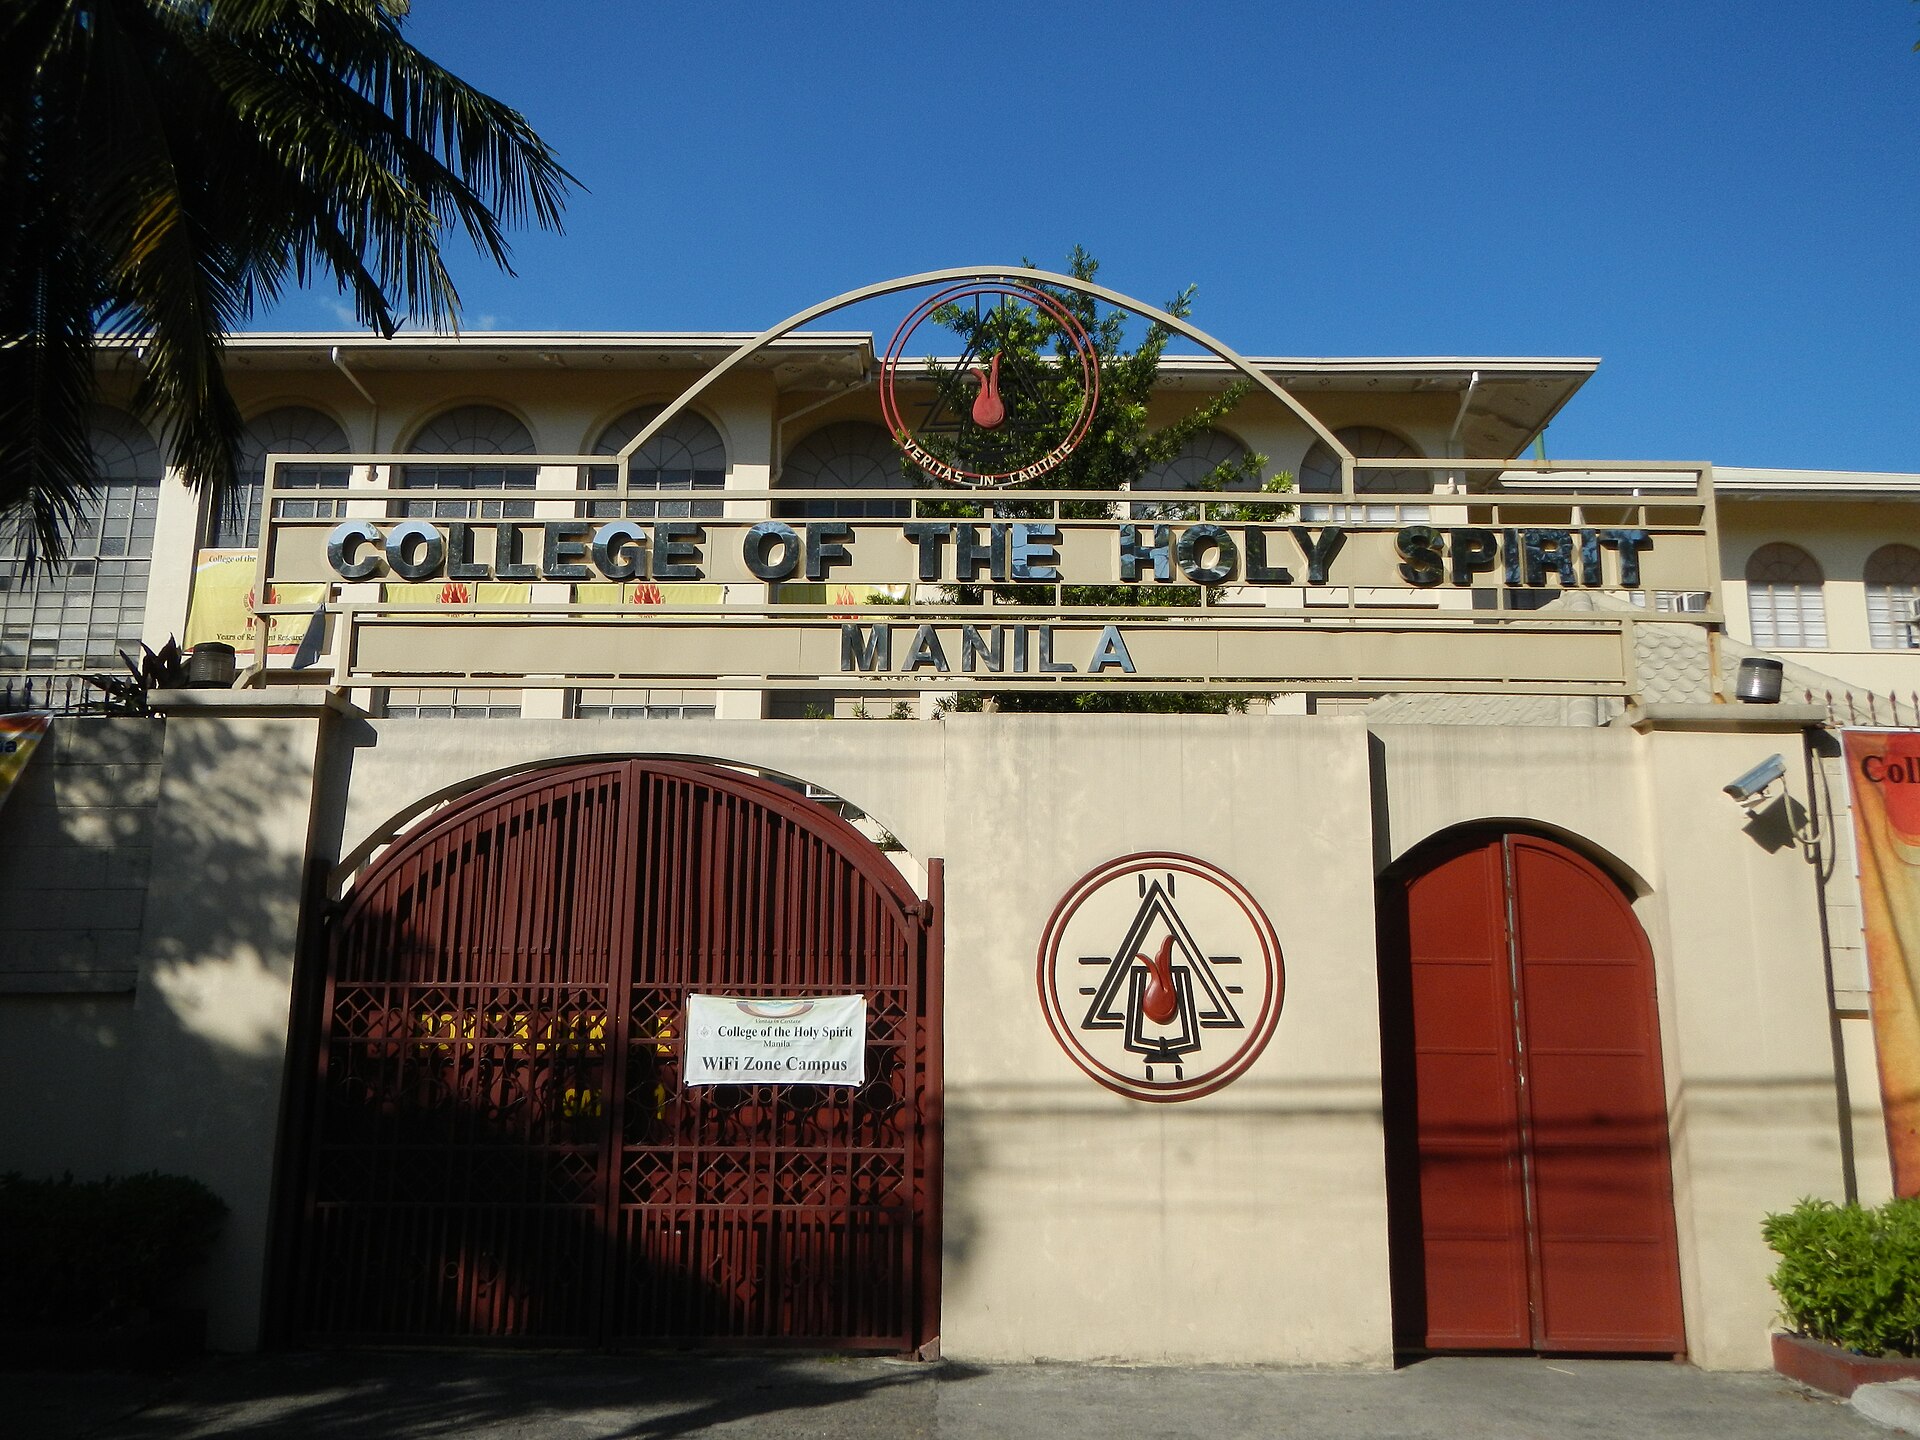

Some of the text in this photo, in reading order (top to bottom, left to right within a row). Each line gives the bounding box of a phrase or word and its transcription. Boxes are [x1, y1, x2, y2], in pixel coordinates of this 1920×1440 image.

[903, 439, 1074, 486] VERITAS IN CARITATE
[209, 554, 257, 564] College of the
[327, 521, 1653, 587] COLLEGE OF THE HOLY SPIRIT
[216, 633, 236, 641] Years
[237, 633, 245, 641] of
[839, 623, 1137, 674] MANILA
[717, 1025, 853, 1040] College of the Holy Spirit
[763, 1040, 791, 1048] Manila
[702, 1056, 848, 1074] WiFi Zone Campus
